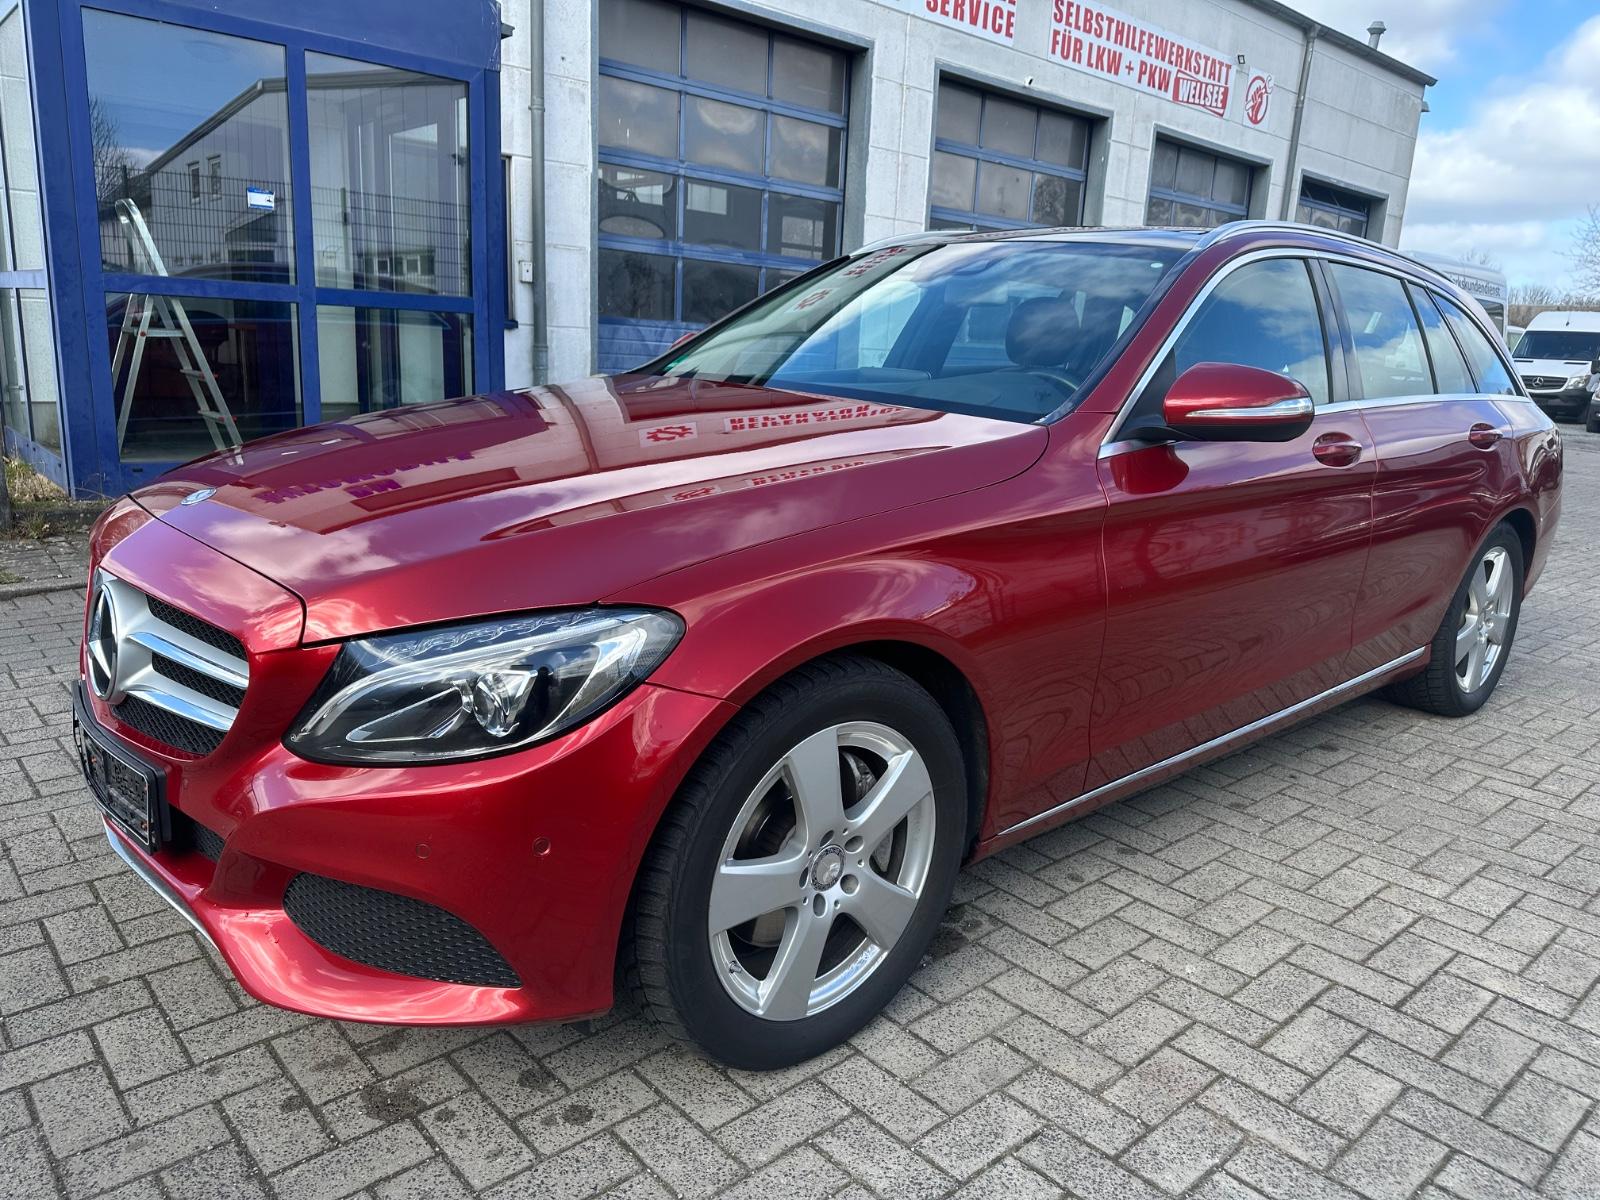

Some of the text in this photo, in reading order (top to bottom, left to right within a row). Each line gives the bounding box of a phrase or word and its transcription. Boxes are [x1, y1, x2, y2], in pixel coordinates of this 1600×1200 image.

[1051, 28, 1172, 93] FÜR LKW + PKW
[1053, 0, 1232, 86] SELBSTHILFEWERKSTATT
[1178, 78, 1224, 109] WELLSEE
[1450, 274, 1501, 297] rkskundendienst
